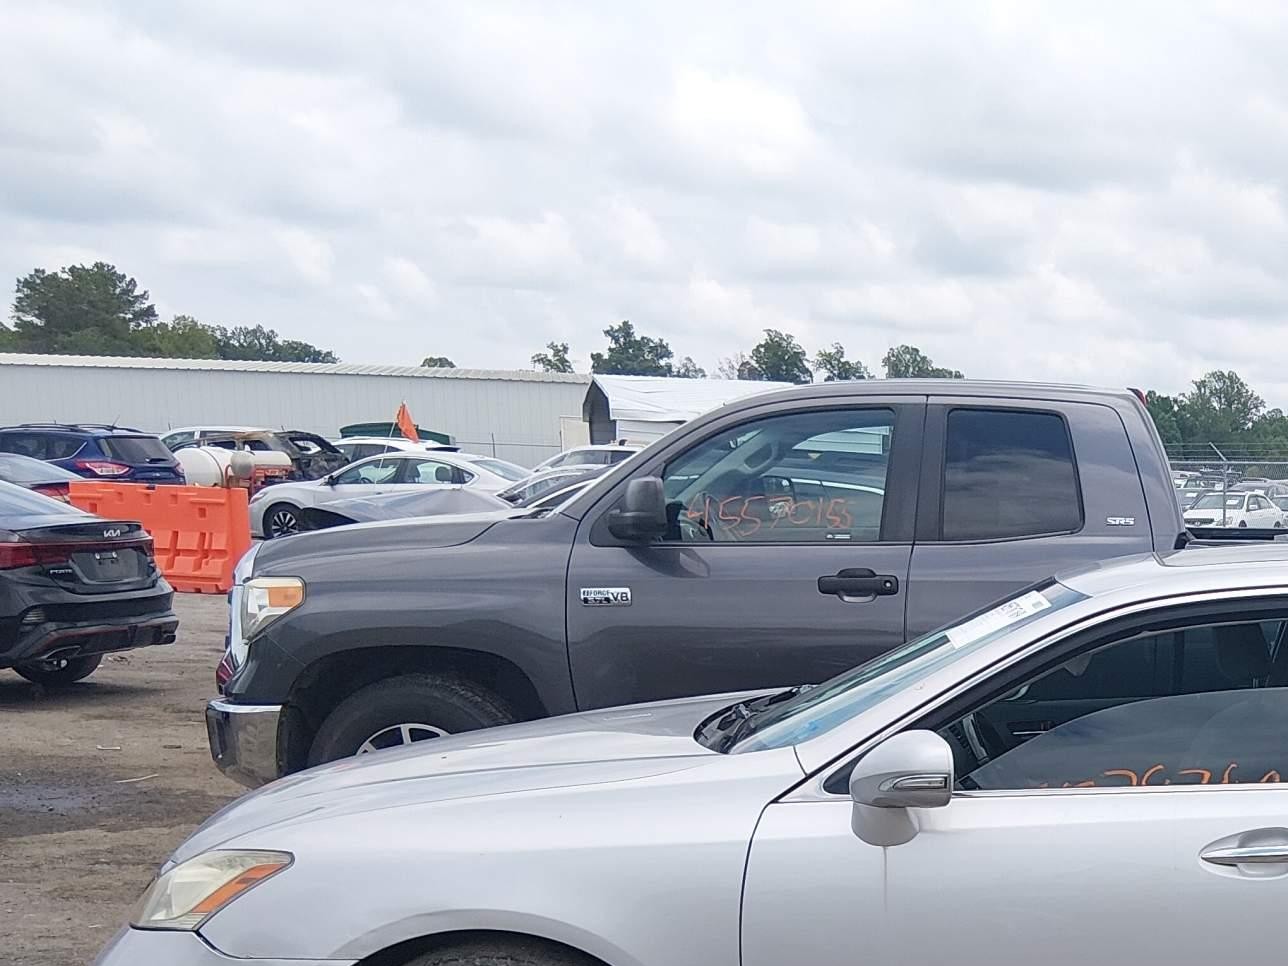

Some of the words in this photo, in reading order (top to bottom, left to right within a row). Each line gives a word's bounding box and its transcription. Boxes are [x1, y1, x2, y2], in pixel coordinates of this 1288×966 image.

[1106, 517, 1135, 526] SR5
[103, 529, 121, 538] KIA
[610, 591, 630, 602] V8
